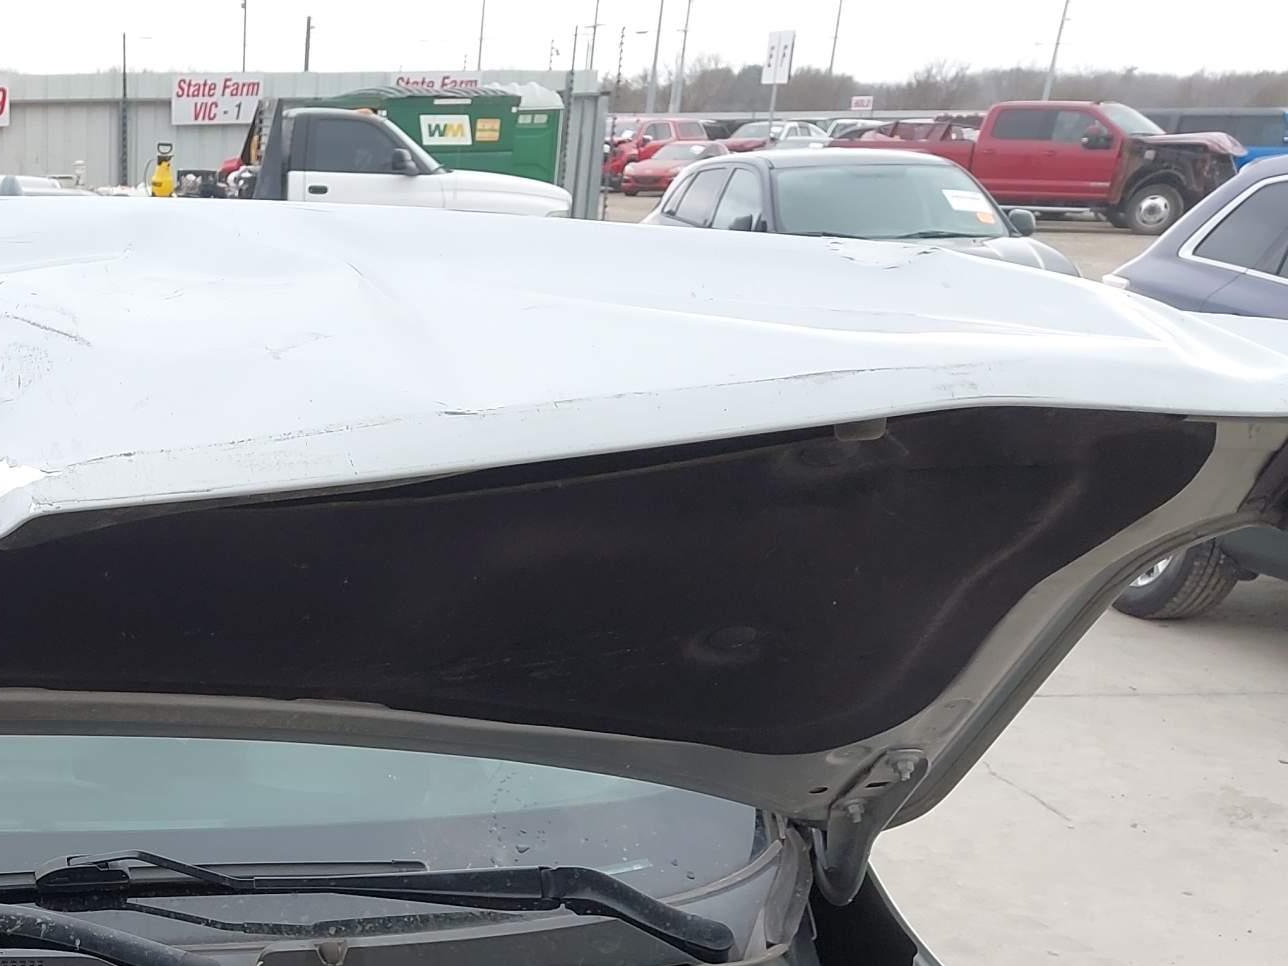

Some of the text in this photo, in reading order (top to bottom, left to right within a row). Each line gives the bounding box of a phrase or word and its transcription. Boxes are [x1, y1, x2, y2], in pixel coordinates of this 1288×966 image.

[176, 78, 260, 98] State Farm
[194, 101, 218, 121] VIC
[234, 101, 243, 121] 1
[427, 123, 465, 138] WM
